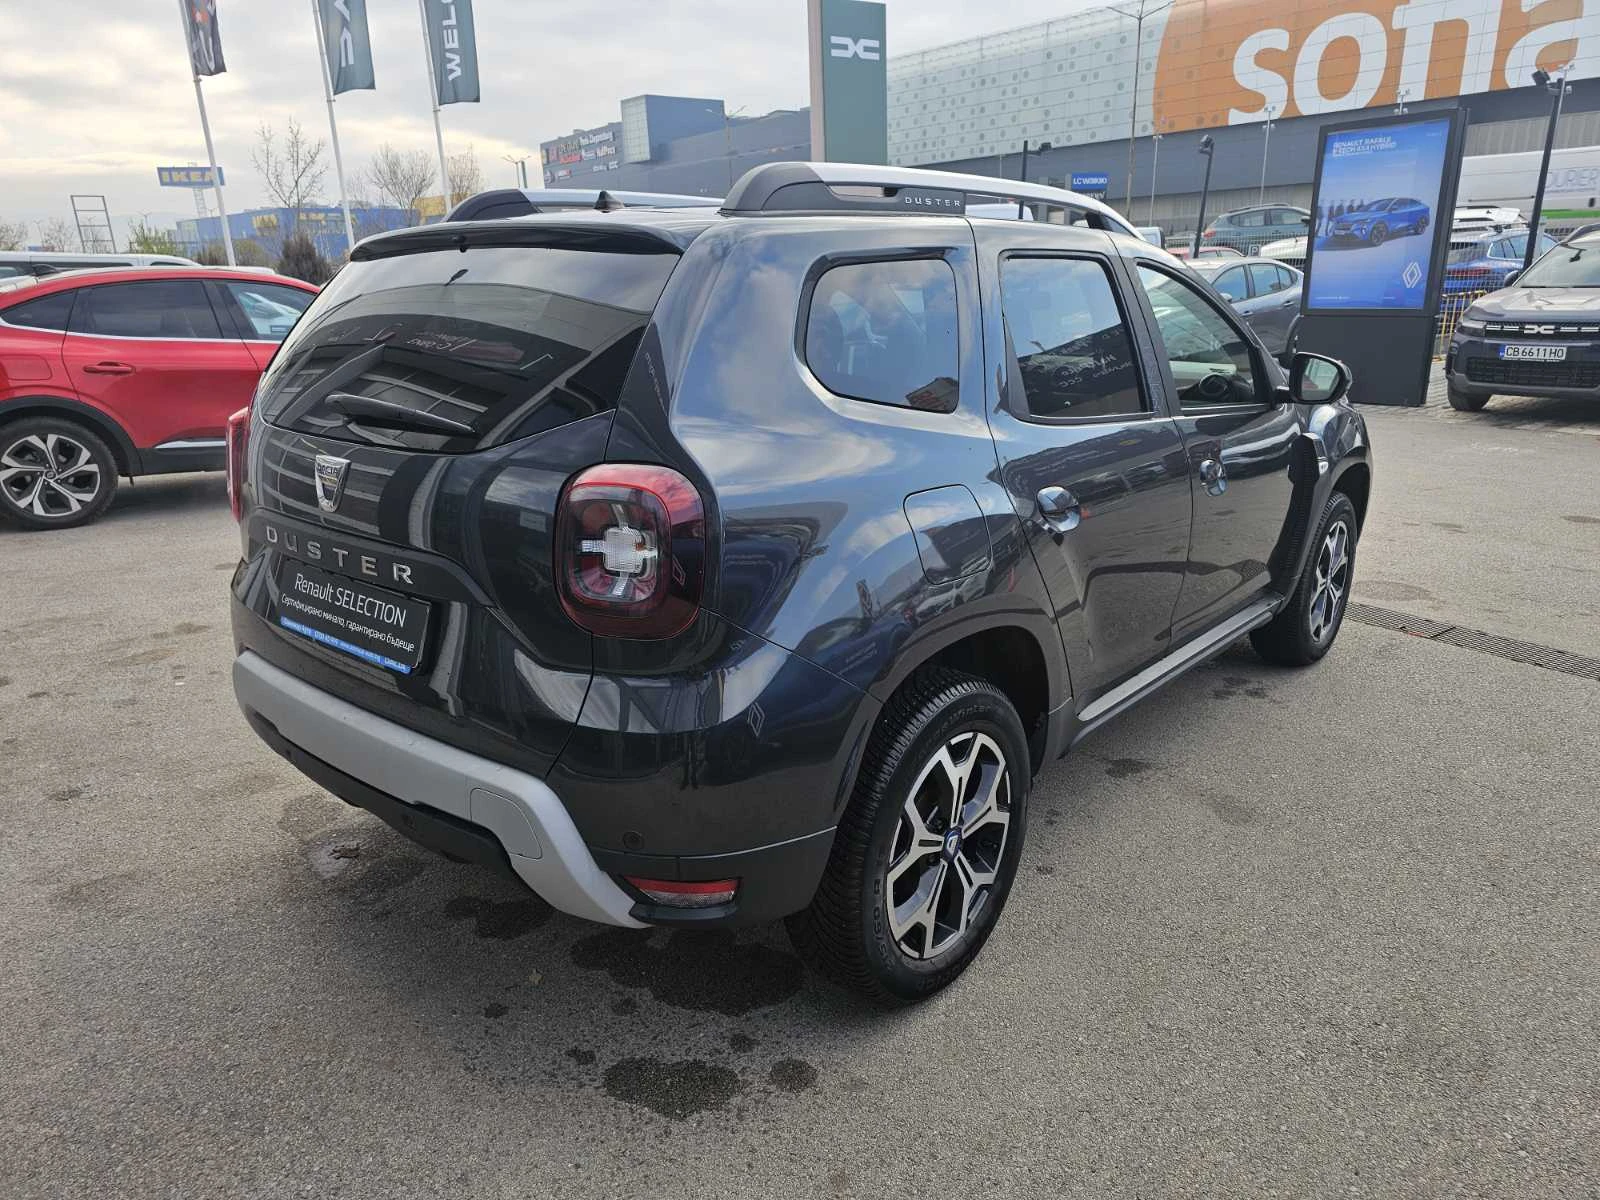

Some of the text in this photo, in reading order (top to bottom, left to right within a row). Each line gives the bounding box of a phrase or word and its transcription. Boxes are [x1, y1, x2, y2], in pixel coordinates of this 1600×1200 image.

[905, 196, 960, 207] DUSTER
[1521, 347, 1546, 357] 6611
[266, 526, 413, 585] DUSTER
[294, 573, 334, 603] Renault
[334, 587, 407, 628] SELECTION
[345, 620, 386, 641] гарантирано
[386, 633, 415, 652] бъдеще
